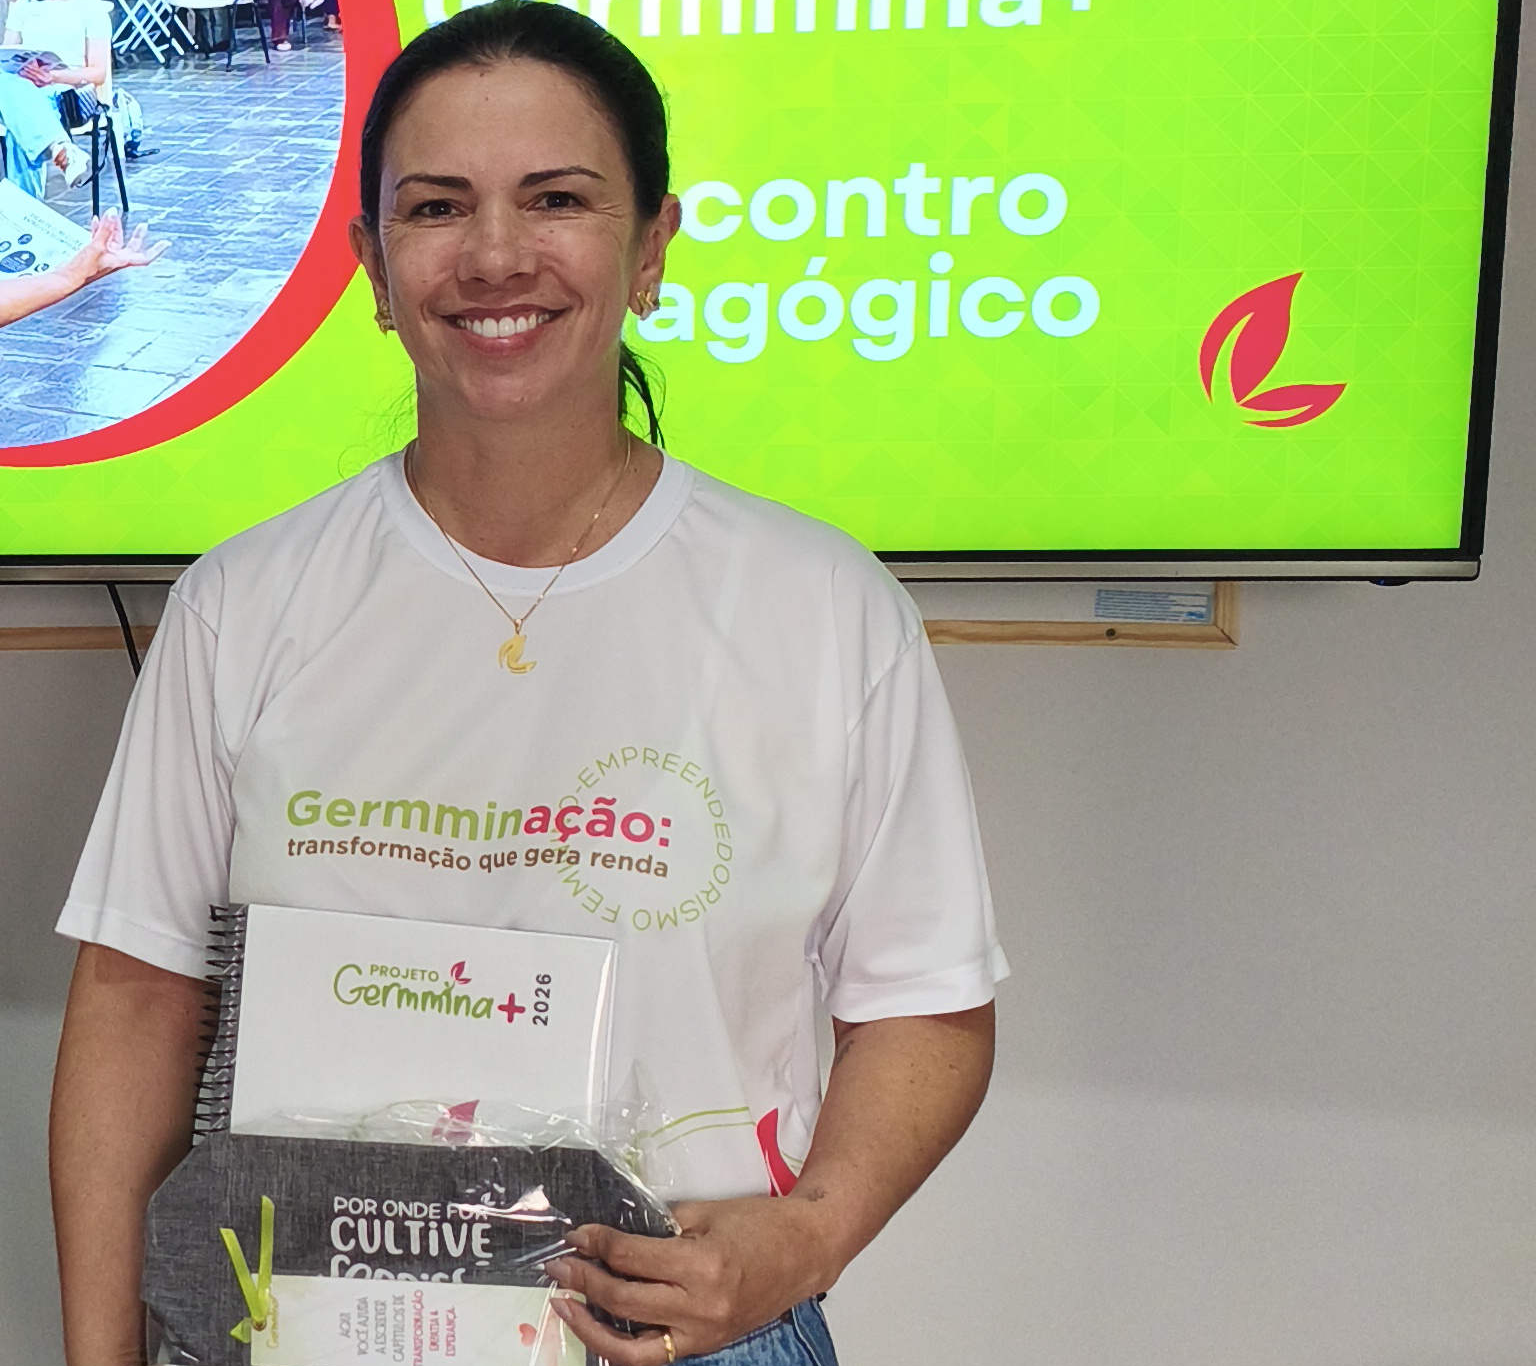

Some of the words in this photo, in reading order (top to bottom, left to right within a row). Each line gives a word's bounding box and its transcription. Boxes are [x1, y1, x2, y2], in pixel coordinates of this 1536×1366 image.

[680, 162, 1068, 242] contro
[637, 251, 1101, 364] agógico
[287, 789, 672, 847] Germminação:
[287, 836, 471, 871] transformação
[479, 847, 518, 873] que
[524, 845, 581, 867] gera
[590, 851, 668, 878] renda
[369, 964, 439, 983] PROJETO
[532, 973, 552, 1026] 2026
[333, 1196, 377, 1215] POR
[382, 1199, 441, 1220] ONDE
[446, 1202, 488, 1220] FO
